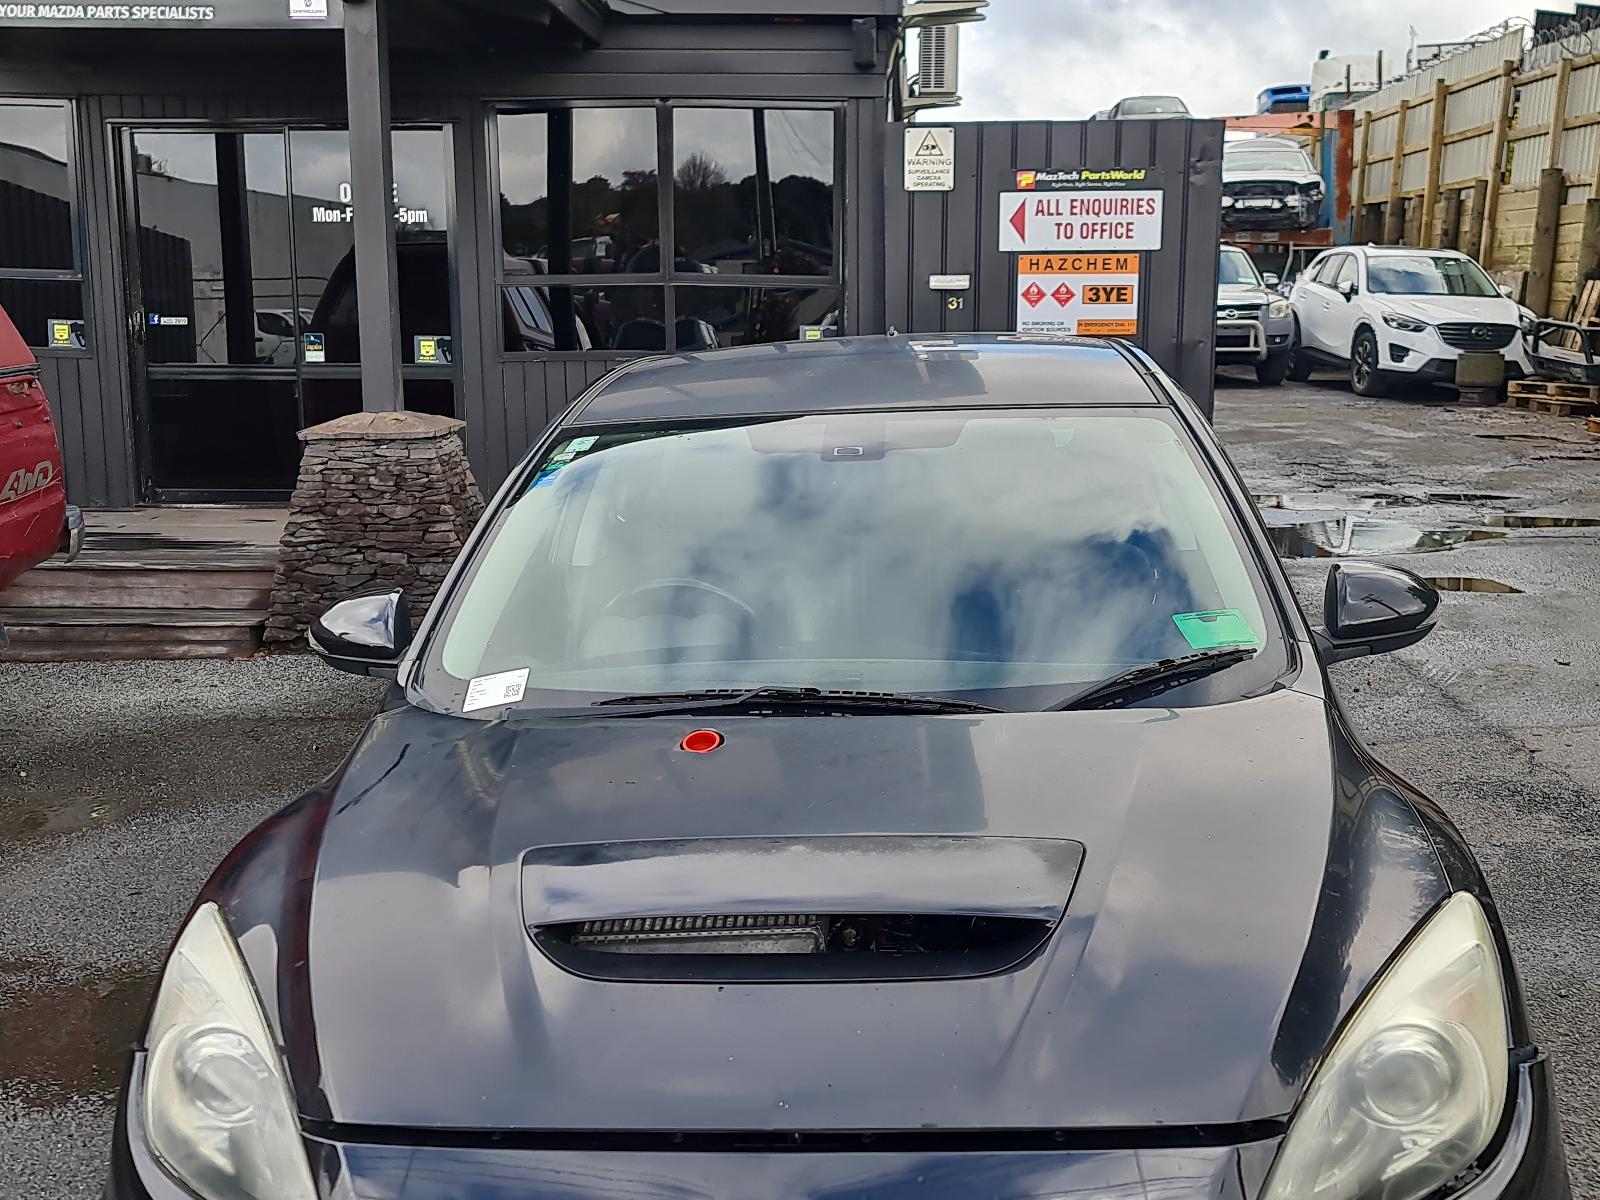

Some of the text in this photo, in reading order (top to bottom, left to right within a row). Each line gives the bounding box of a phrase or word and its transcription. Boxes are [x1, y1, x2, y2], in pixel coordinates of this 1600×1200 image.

[0, 4, 214, 20] YOUR MAZDA PARTS SPECIALISTS
[907, 158, 952, 166] WARNING
[1081, 169, 1147, 180] PartsWorld
[1035, 198, 1156, 217] ALL ENQUIRIES
[1055, 221, 1135, 240] TO OFFICE
[1029, 257, 1128, 271] HAZCHEM
[1088, 286, 1128, 303] 3YE
[947, 297, 964, 310] 31
